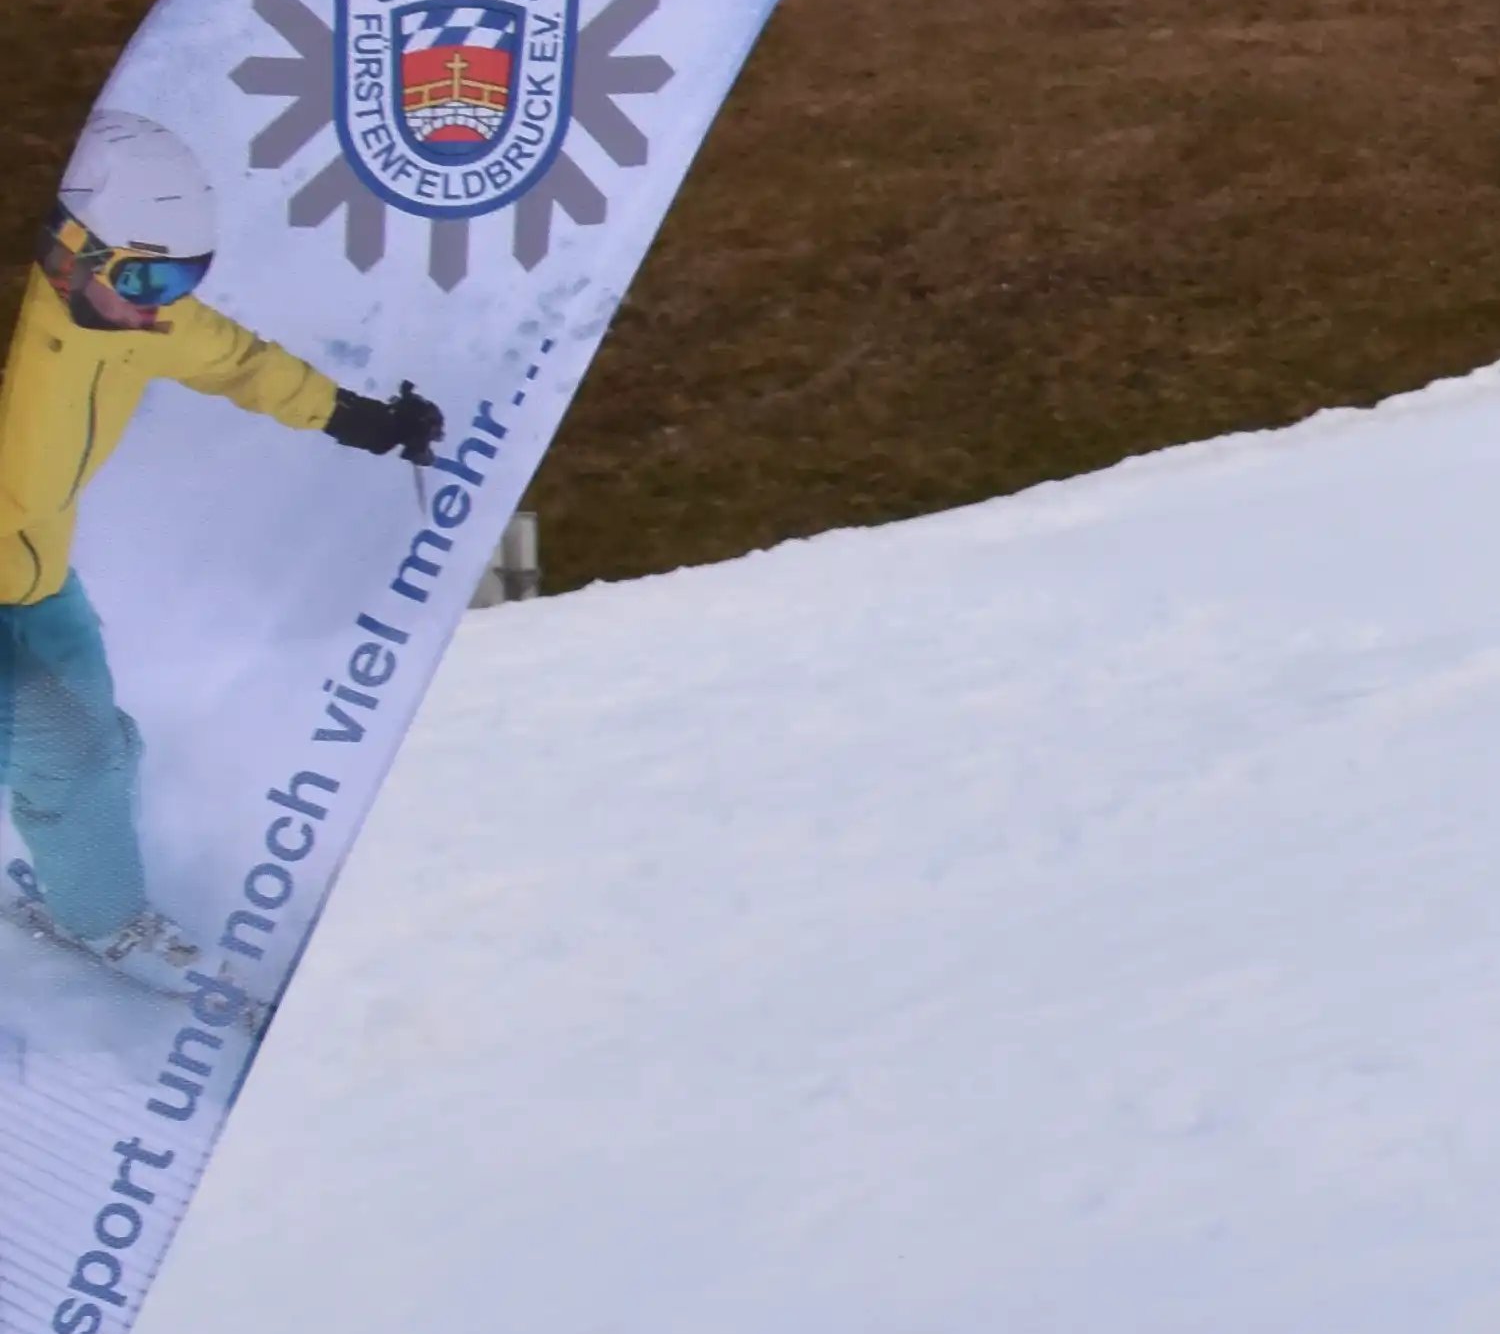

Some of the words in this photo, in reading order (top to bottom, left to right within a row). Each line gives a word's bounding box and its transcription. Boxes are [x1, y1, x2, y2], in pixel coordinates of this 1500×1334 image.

[351, 13, 560, 202] FÜRSTENFELDBRUCK
[147, 970, 247, 1122] und
[218, 772, 340, 963] noch
[310, 612, 409, 760] viel
